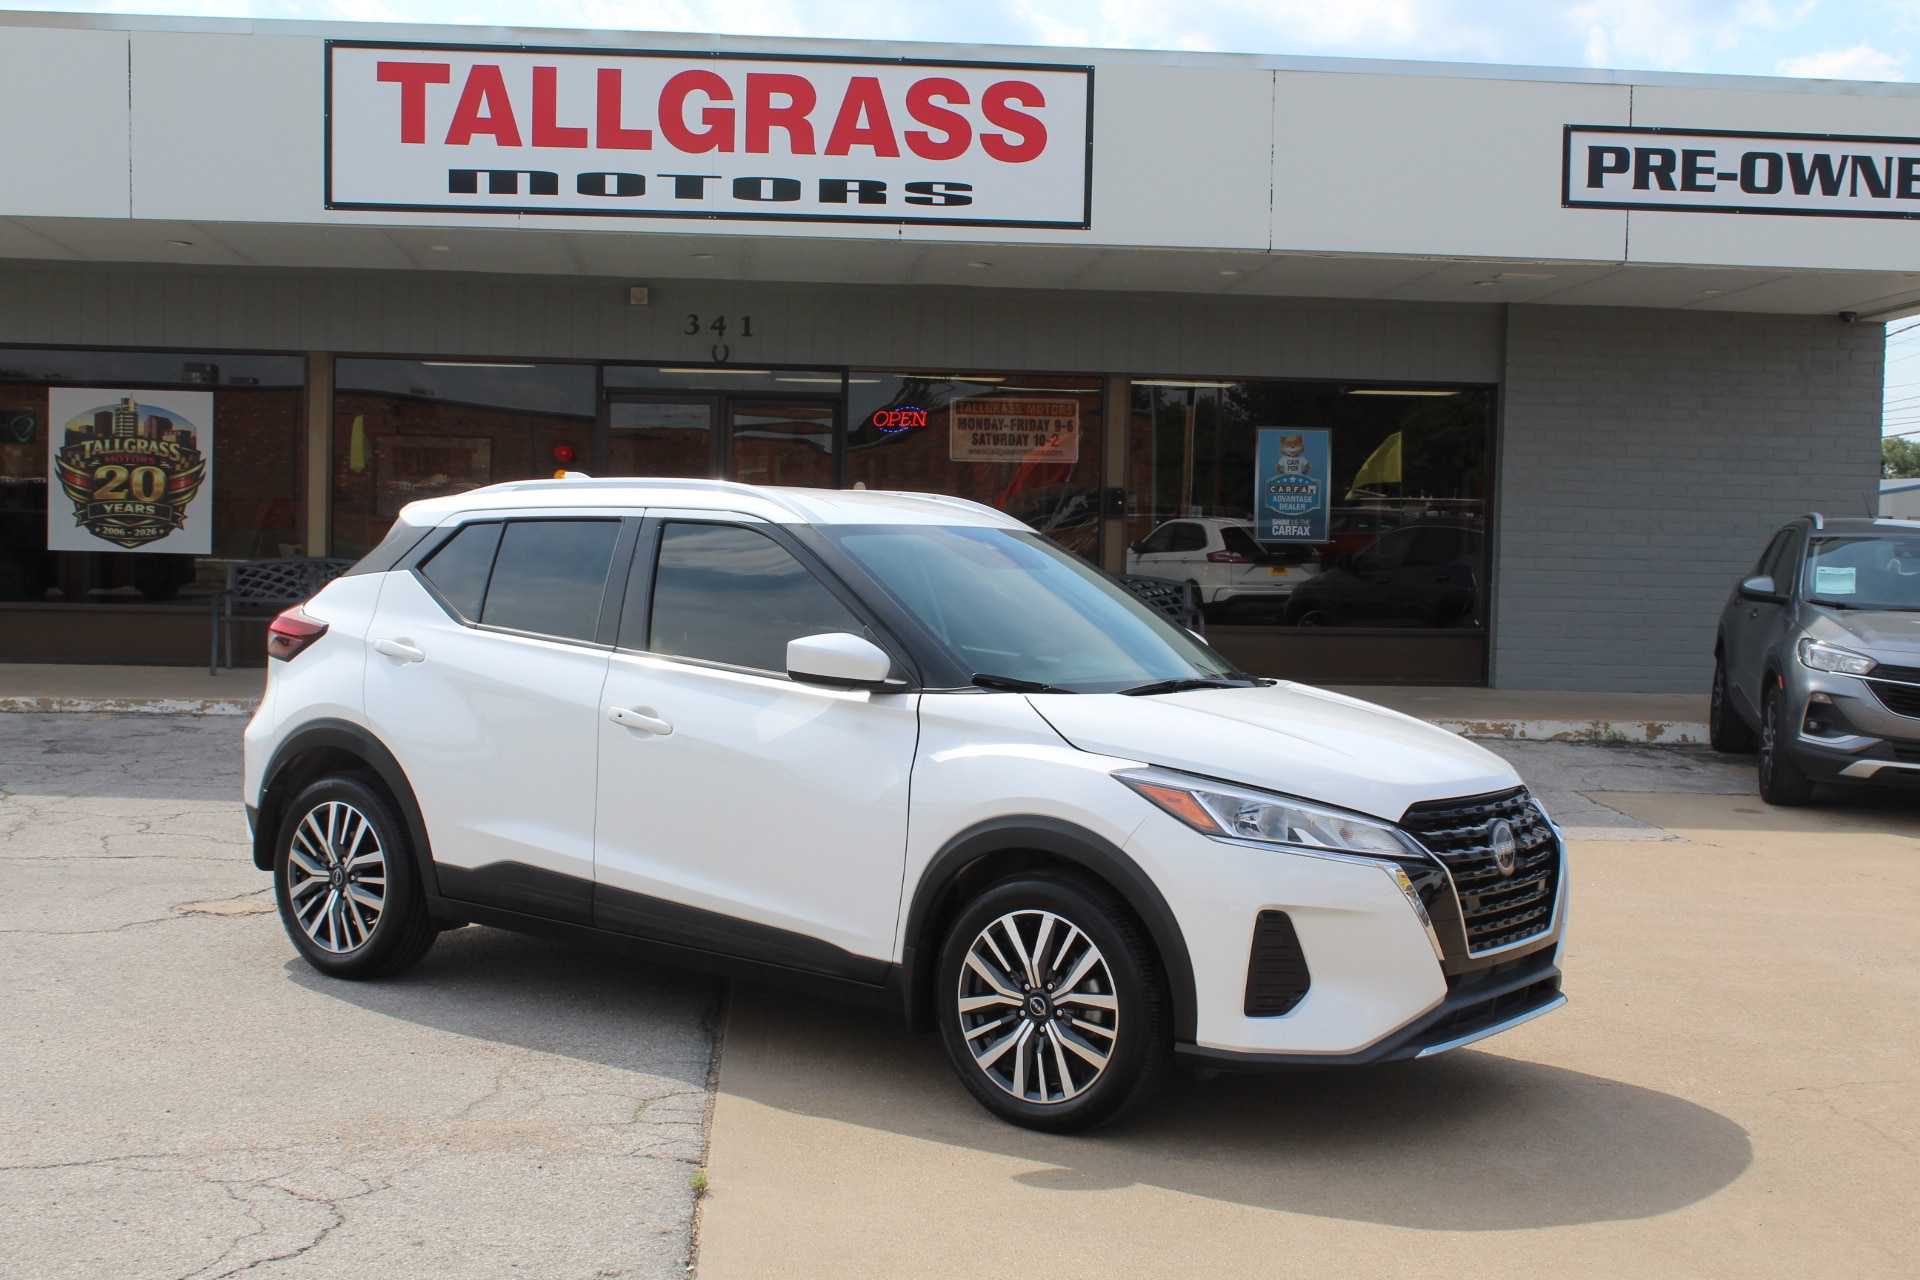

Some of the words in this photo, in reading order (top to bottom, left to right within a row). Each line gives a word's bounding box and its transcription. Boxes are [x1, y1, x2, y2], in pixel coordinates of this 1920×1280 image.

[377, 61, 1048, 163] TALLGRASS
[1586, 145, 1920, 199] PRE-OWNE
[448, 168, 973, 206] MOTORS
[683, 313, 753, 337] 341
[959, 402, 1022, 414] TALLGRASS
[1026, 404, 1074, 416] MOTORS
[872, 410, 928, 427] OPEN
[1054, 419, 1074, 433] 9-6
[971, 432, 1029, 446] SATURDAY
[1033, 433, 1060, 448] 10-2
[81, 438, 181, 461] TALLGRASS
[104, 455, 156, 464] MOTORS
[93, 465, 167, 502] 20
[1270, 486, 1316, 494] CARFAX
[1272, 495, 1313, 503] ADVANTAGE
[103, 503, 156, 514] YEARS
[1279, 503, 1306, 511] DEALER
[102, 526, 126, 536] 2006
[134, 527, 157, 536] 2026
[1271, 526, 1311, 536] CARFAX
